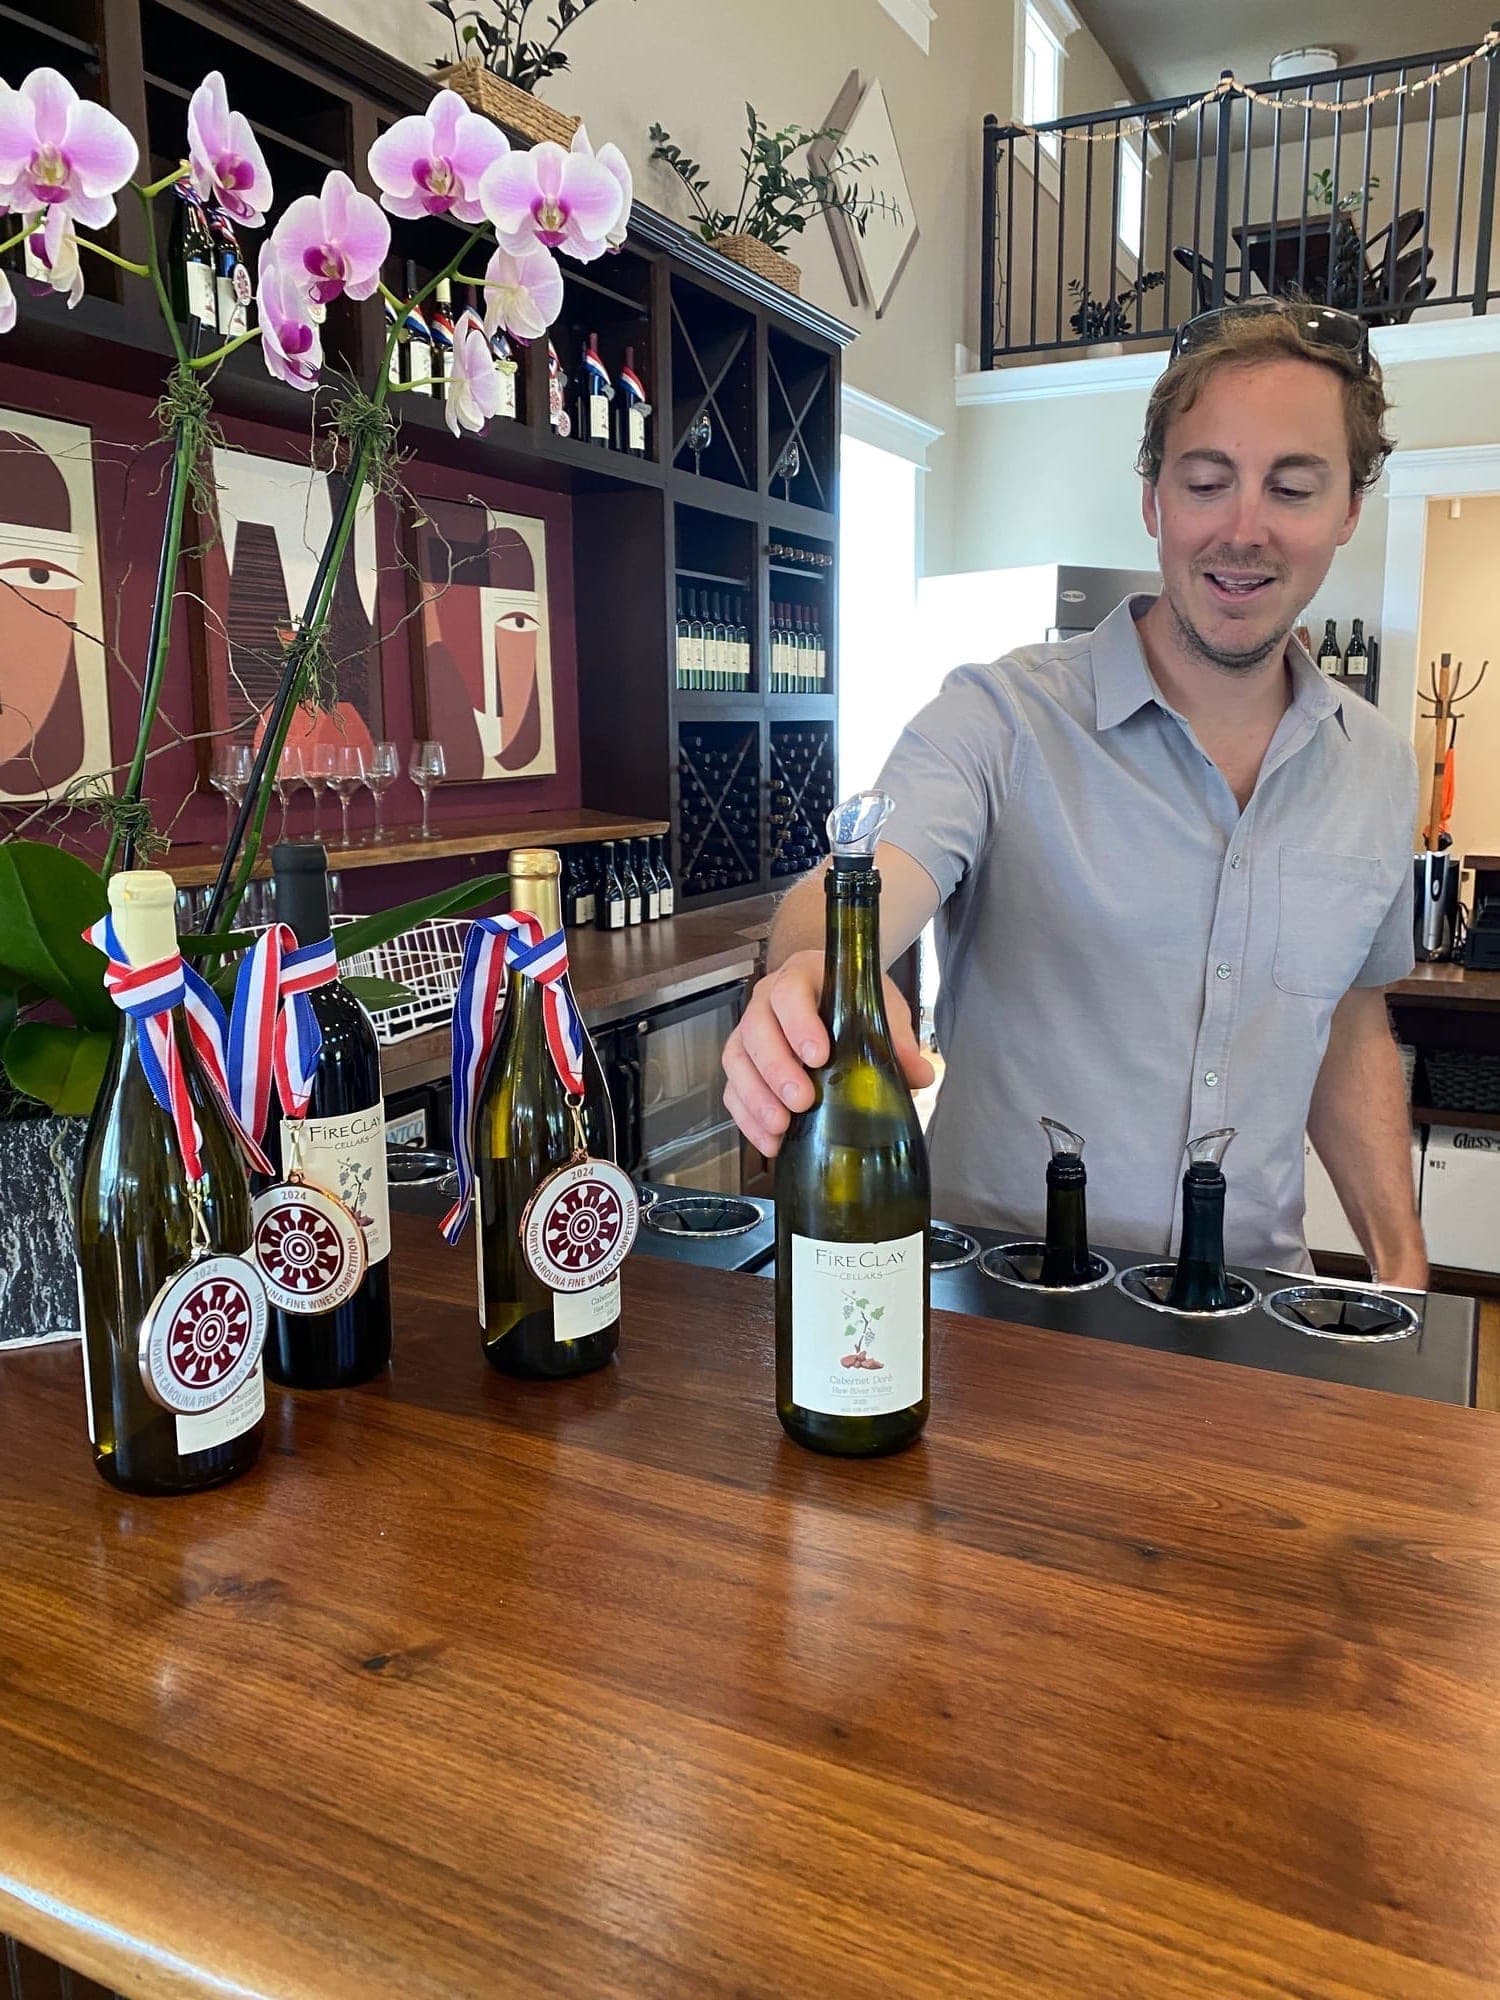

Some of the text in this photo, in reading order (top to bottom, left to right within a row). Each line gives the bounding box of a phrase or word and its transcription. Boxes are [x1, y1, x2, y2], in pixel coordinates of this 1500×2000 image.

[334, 1136, 370, 1150] CELLARS
[571, 1167, 594, 1181] 2024
[281, 1190, 307, 1201] 2024
[530, 1200, 635, 1288] NORTH CAROLINA FINE WINES COMPETITION
[193, 1263, 219, 1282] 2024
[286, 1297, 307, 1309] FINE
[307, 1293, 337, 1309] WINES
[335, 1237, 358, 1297] COMPETITION
[839, 1271, 883, 1281] CELLARS
[151, 1338, 165, 1379] NORTH
[160, 1377, 196, 1409] CAROLINA
[197, 1391, 218, 1408] FINE
[219, 1367, 246, 1398] WINES
[244, 1293, 265, 1367] COMPETITION
